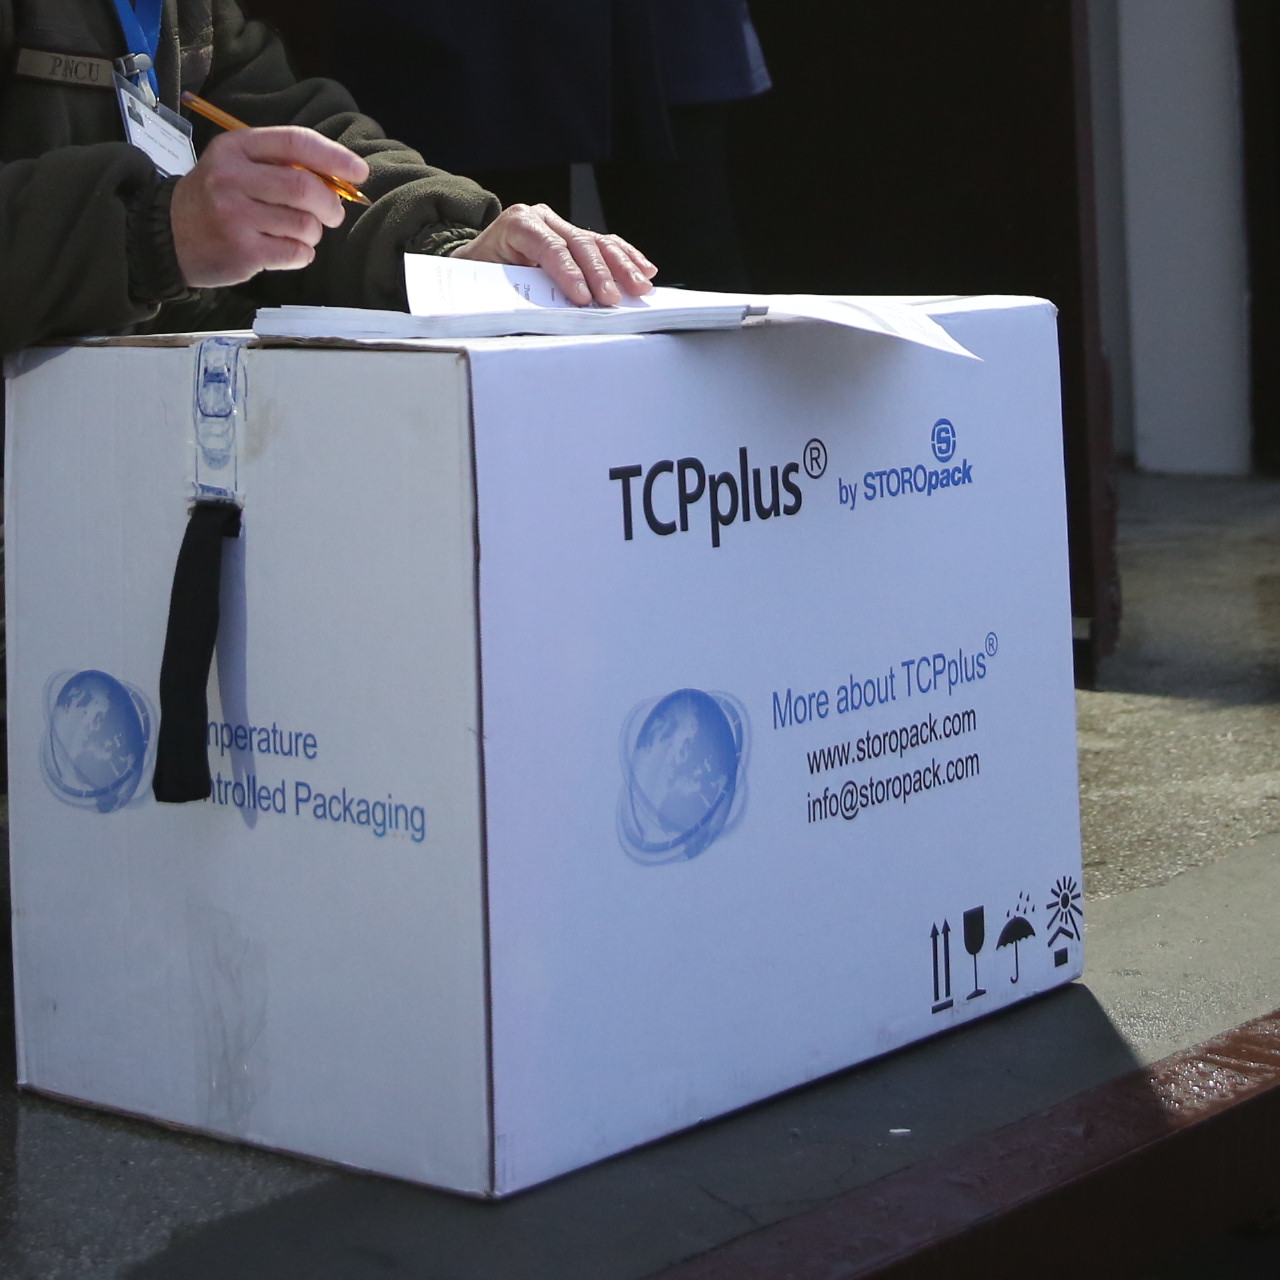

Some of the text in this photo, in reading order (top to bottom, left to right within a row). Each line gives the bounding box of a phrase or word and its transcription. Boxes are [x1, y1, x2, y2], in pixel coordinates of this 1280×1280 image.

[838, 478, 857, 511] by
[863, 459, 973, 501] STOROpack
[771, 688, 829, 730] More
[836, 666, 896, 713] about
[208, 721, 318, 760] mperature
[807, 706, 977, 775] www.storopack.com
[206, 772, 426, 843] ntrolled Packaging
[807, 750, 980, 824] info@storopack.com
